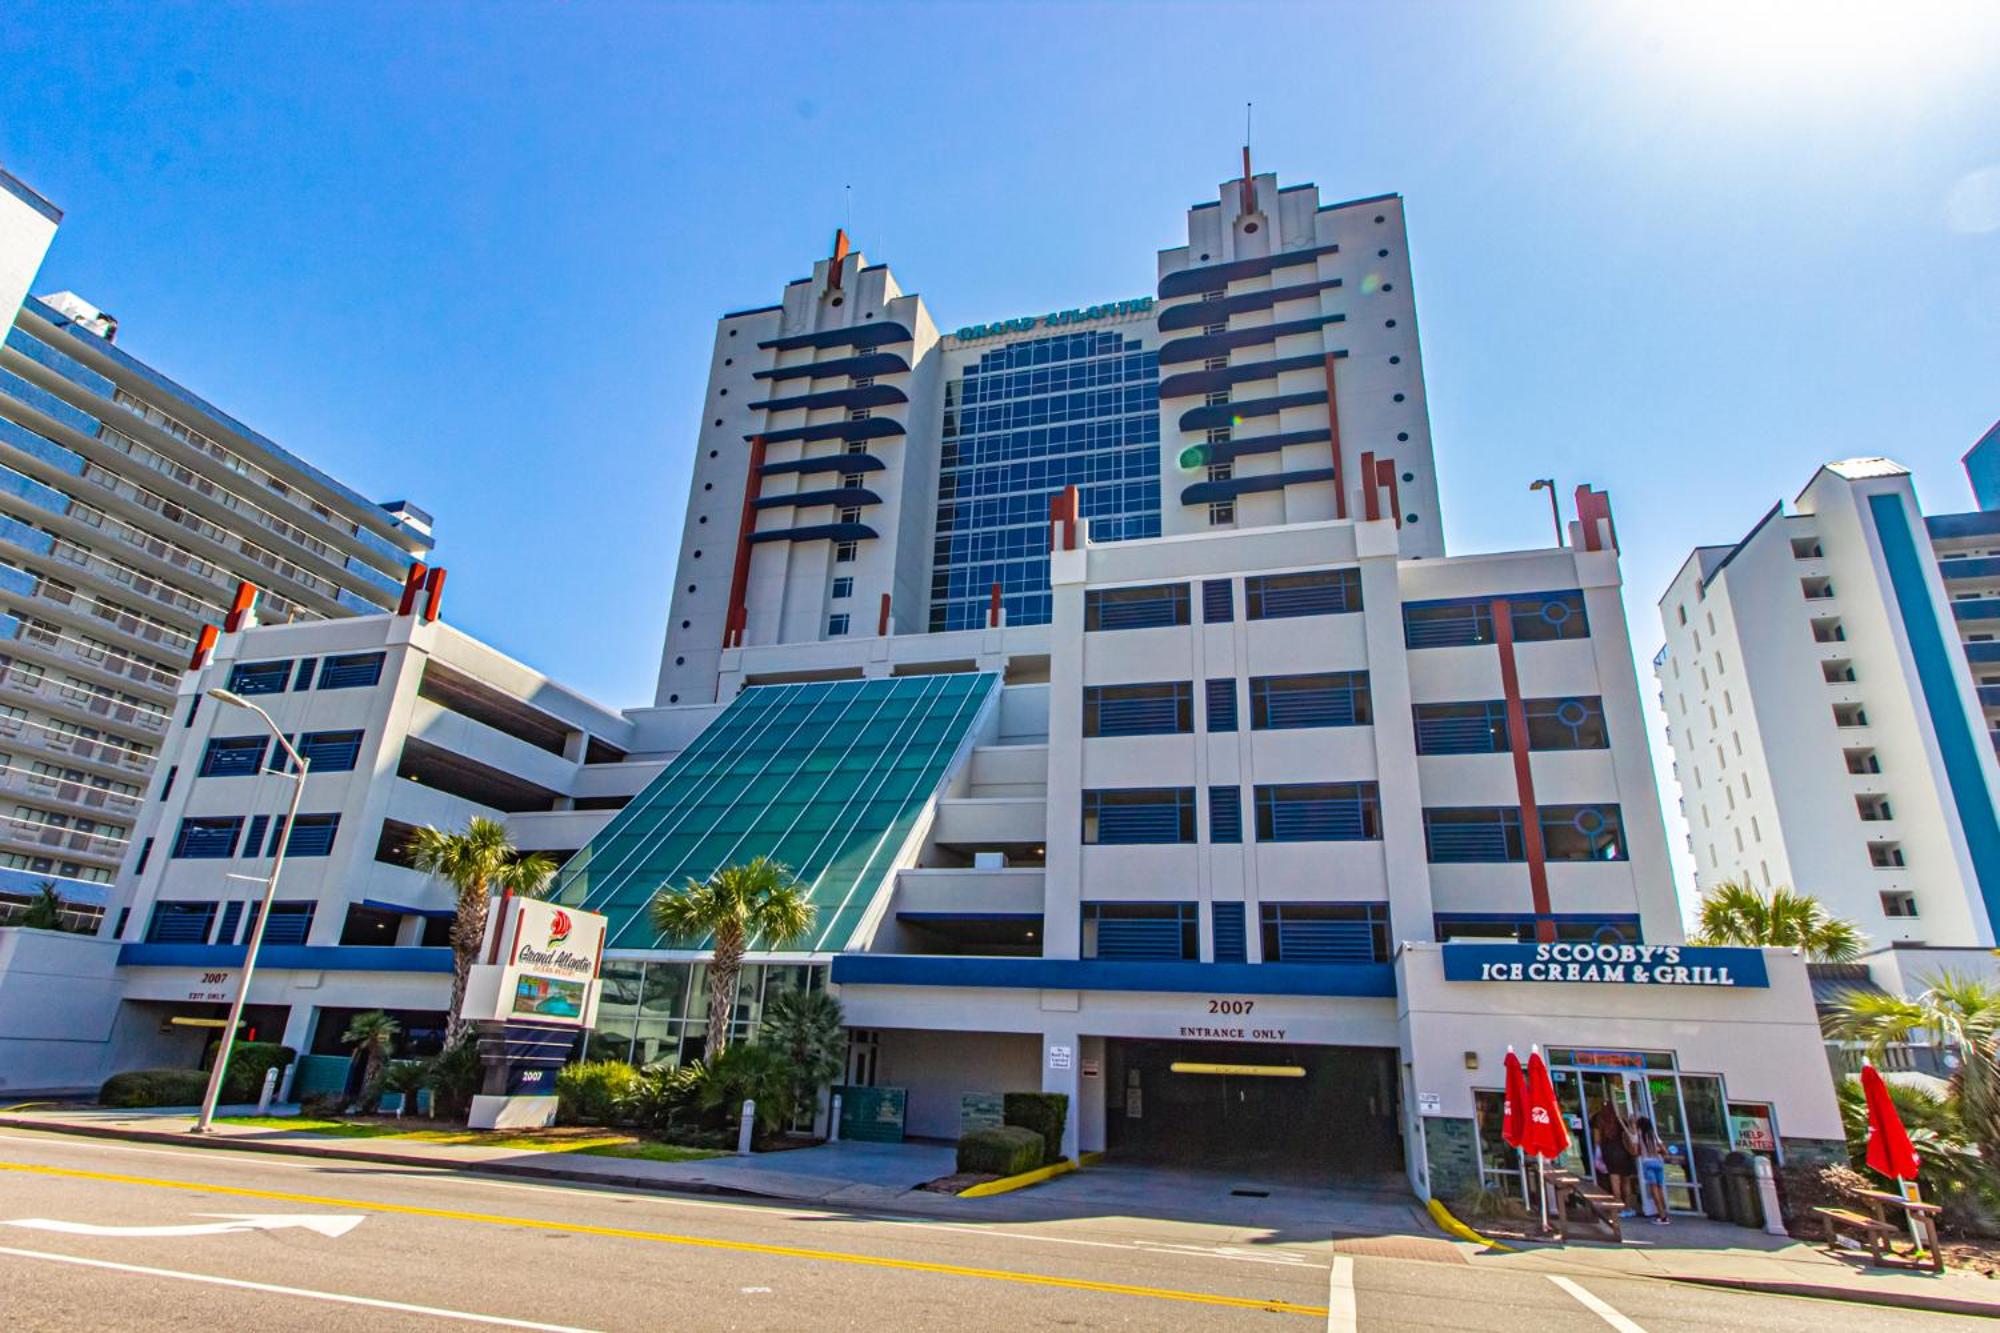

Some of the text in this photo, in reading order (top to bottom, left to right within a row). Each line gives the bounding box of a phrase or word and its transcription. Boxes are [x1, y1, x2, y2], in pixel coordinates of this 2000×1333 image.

[1044, 296, 1153, 327] ATLANTIC
[518, 944, 592, 973] Grand Atlantic
[1535, 944, 1680, 963] SCOOBY'S
[201, 972, 228, 984] 2007
[1481, 963, 1734, 985] ICE CREAM & GRILL
[1208, 1000, 1255, 1015] 2007
[1180, 1027, 1286, 1040] ENTRANCE ONLY
[522, 1071, 544, 1082] 2007
